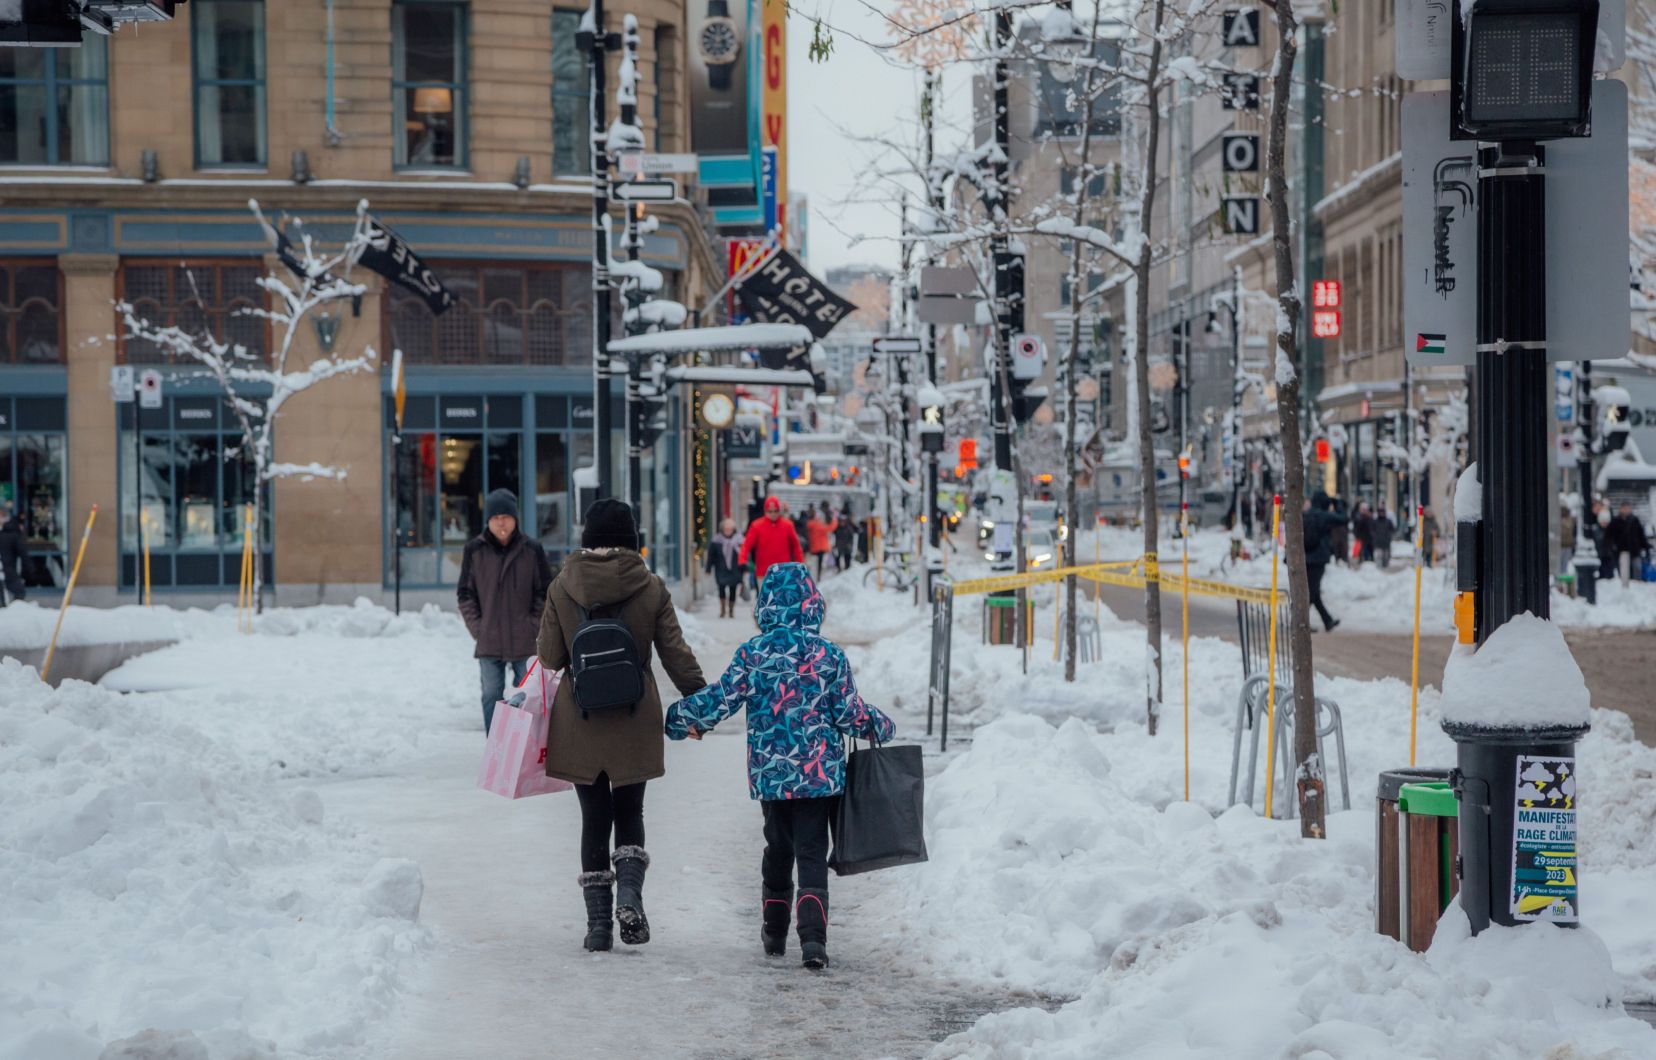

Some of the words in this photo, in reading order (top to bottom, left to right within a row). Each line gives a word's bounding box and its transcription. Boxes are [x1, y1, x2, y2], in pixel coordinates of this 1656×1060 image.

[1517, 828, 1546, 840] RAGE
[1534, 856, 1546, 866] 29
[1546, 870, 1566, 880] 2023
